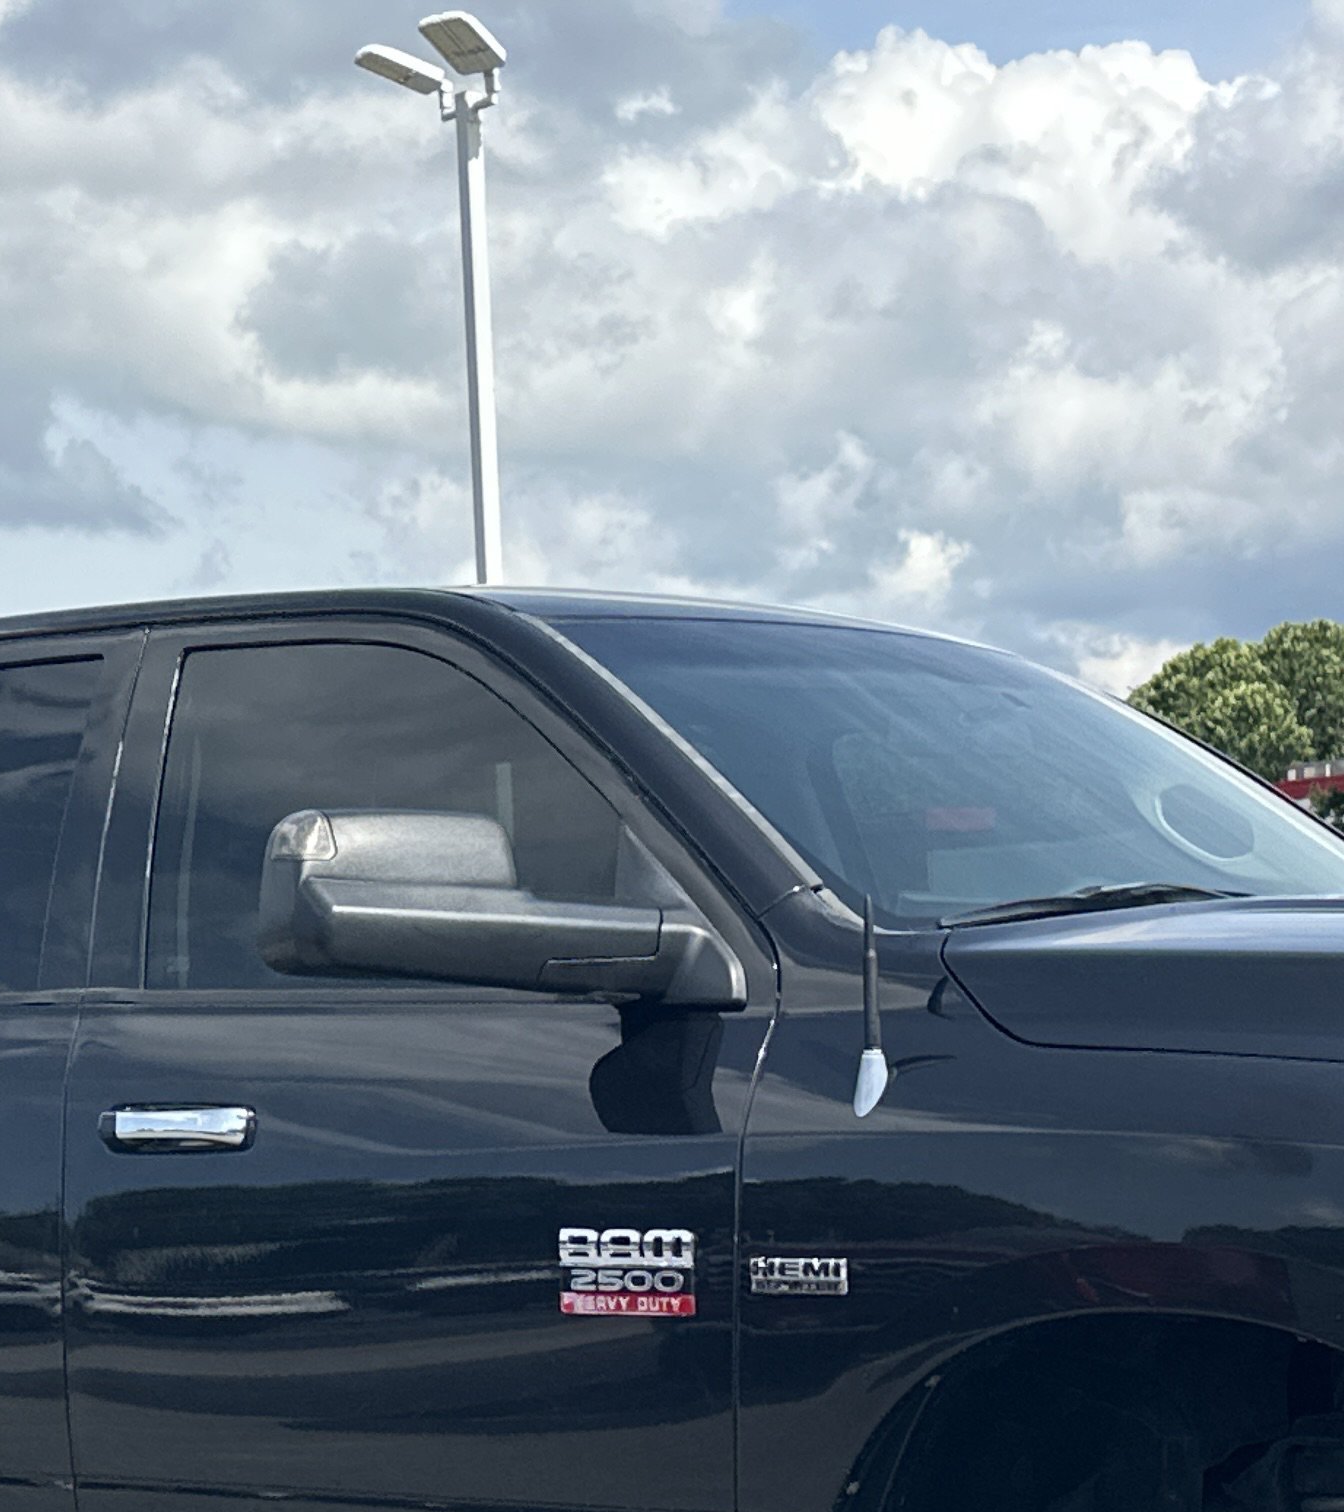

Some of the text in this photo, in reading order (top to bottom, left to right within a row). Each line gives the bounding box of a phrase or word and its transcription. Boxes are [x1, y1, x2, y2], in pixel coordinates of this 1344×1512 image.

[559, 1228, 694, 1267] RAM
[752, 1258, 844, 1278] HEMI
[570, 1269, 684, 1292] 2500
[637, 1297, 681, 1312] DUTY
